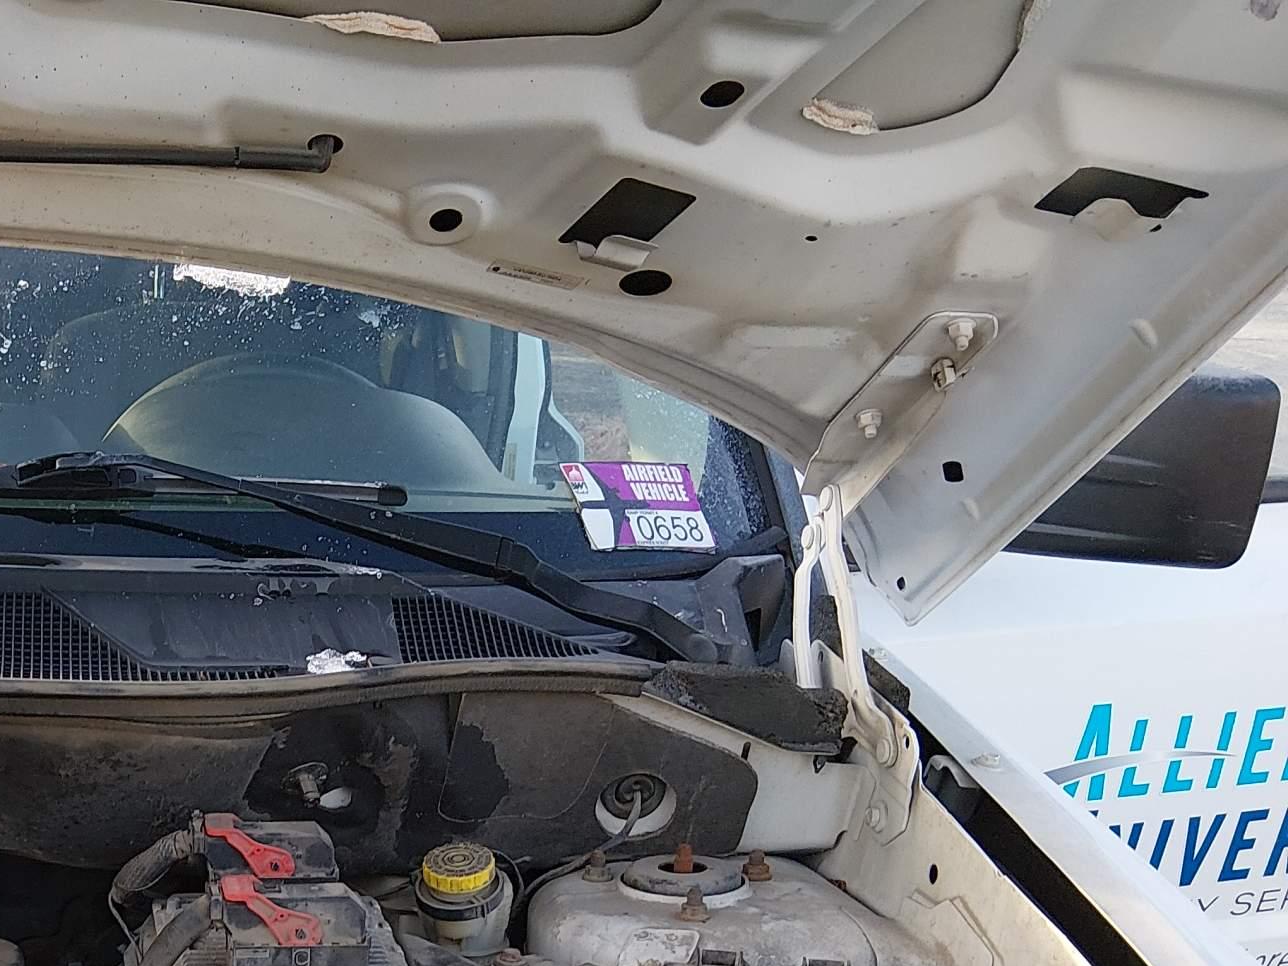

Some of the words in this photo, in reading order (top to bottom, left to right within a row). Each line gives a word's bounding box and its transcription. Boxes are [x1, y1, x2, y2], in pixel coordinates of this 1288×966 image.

[621, 464, 683, 482] AIRFIELD
[629, 482, 690, 502] VEHICLE
[636, 515, 704, 542] 0658
[1063, 703, 1288, 801] ALLIE
